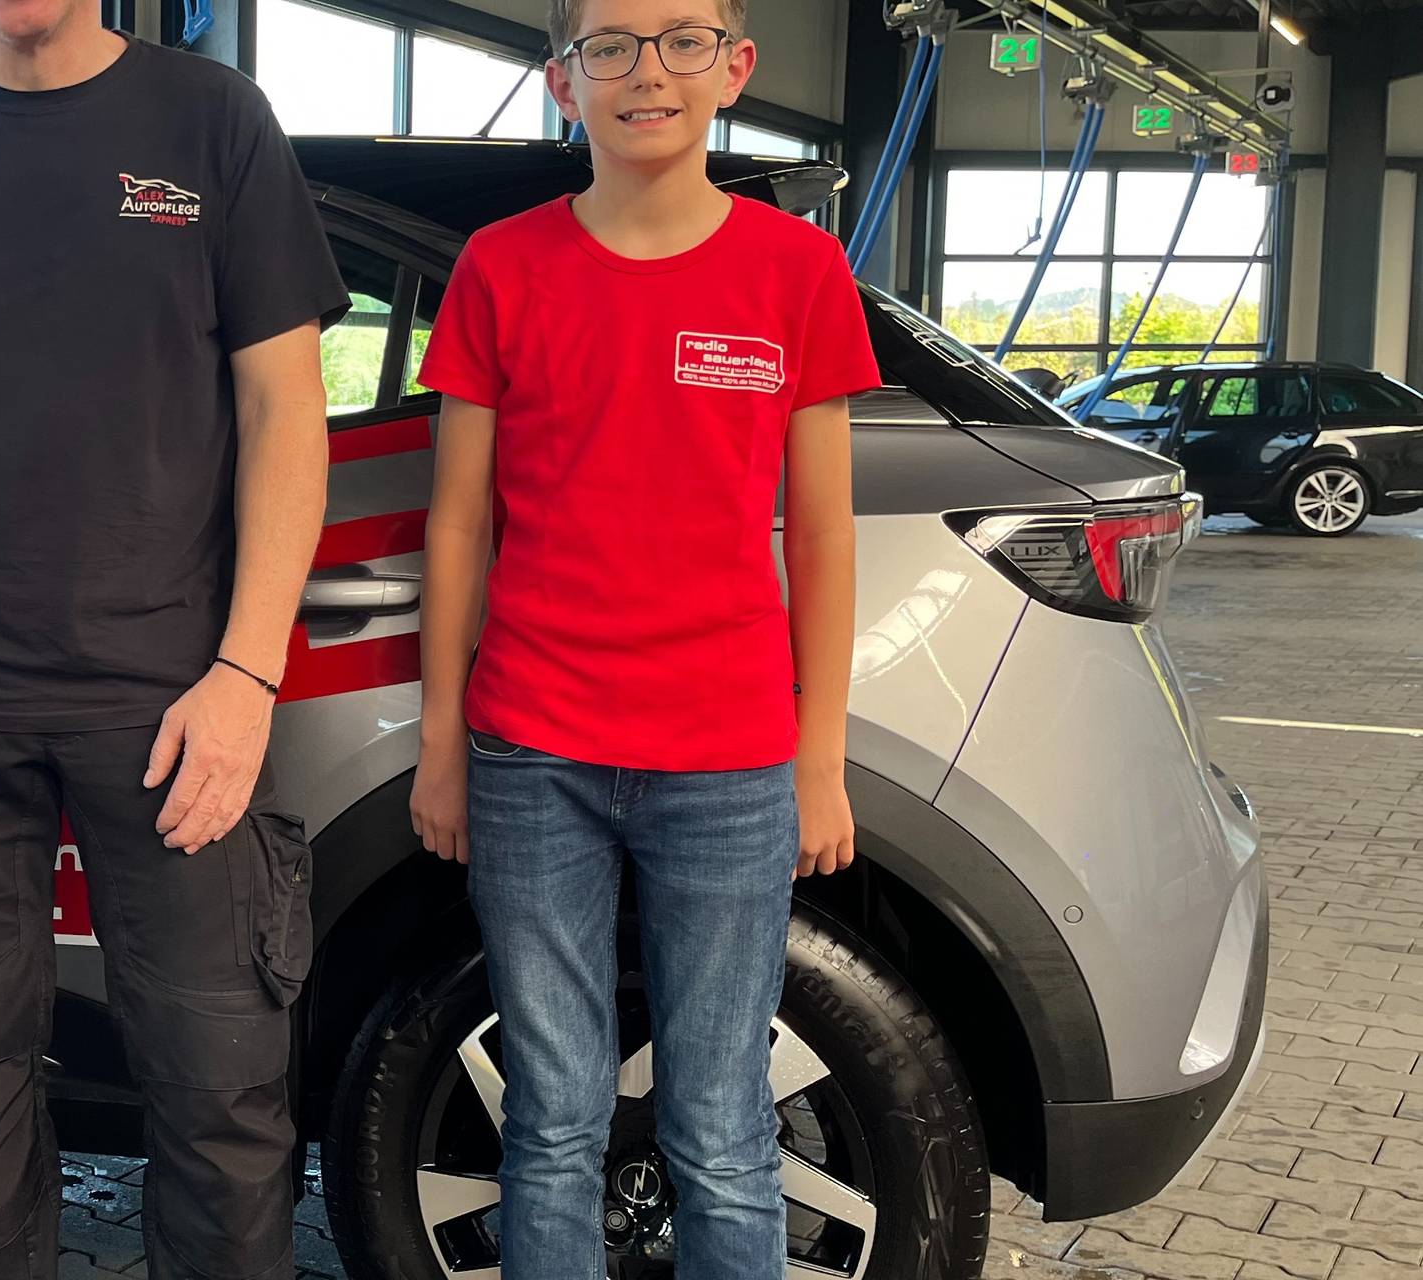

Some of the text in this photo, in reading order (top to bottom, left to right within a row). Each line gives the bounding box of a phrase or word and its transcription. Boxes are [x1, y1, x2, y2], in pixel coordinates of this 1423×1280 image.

[997, 37, 1039, 63] 21
[1137, 107, 1172, 129] 22
[1230, 152, 1259, 172] 23
[135, 191, 165, 201] ALEX
[150, 215, 187, 227] EXPRESS
[685, 340, 728, 353] radio
[702, 353, 777, 371] sauerland
[1010, 546, 1061, 556] LUX
